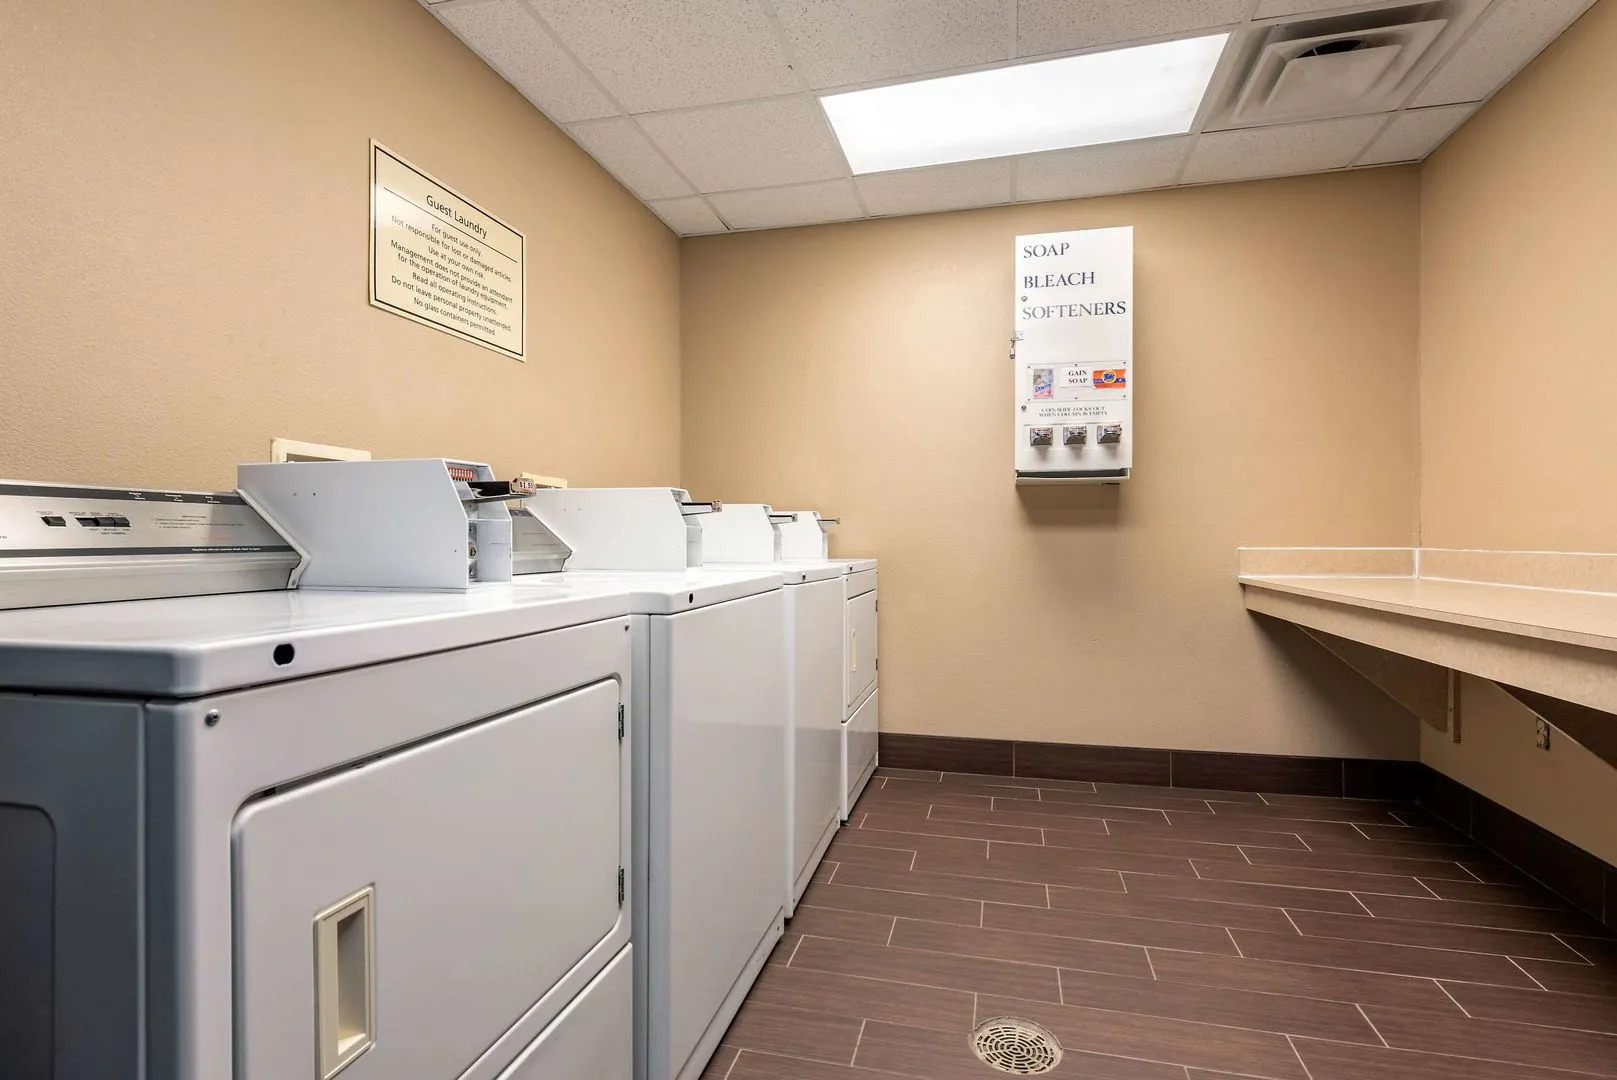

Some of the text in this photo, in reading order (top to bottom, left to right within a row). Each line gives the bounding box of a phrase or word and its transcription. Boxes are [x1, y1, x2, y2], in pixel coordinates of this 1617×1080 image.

[426, 195, 487, 239] Guest Laundry
[391, 215, 404, 228] Not
[405, 223, 440, 246] responsible
[441, 239, 451, 251] for
[451, 245, 461, 257] lost
[470, 255, 494, 274] damaged
[431, 223, 441, 234] For
[442, 231, 458, 244] guest
[459, 240, 469, 250] use
[1023, 242, 1070, 259] SOAP
[391, 239, 513, 304] Management does not provide an attendant
[428, 245, 439, 257] Use
[440, 253, 447, 261] at
[447, 256, 461, 268] your
[461, 264, 474, 274] own
[397, 252, 408, 264] for
[409, 258, 420, 270] the
[421, 265, 451, 284] operation
[451, 278, 459, 287] of
[459, 281, 480, 298] laundry
[412, 272, 429, 285] Read
[429, 279, 437, 289] all
[438, 284, 467, 304] operating
[1024, 271, 1095, 289] BLEACH
[391, 275, 402, 286] Do
[402, 281, 415, 291] not
[415, 285, 432, 299] leave
[433, 294, 458, 310] personal
[458, 304, 482, 321] property
[413, 297, 424, 307] No
[424, 302, 440, 314] glass
[439, 308, 470, 326] containers
[1022, 300, 1126, 320] SOFTENERS
[1068, 369, 1087, 377] GAIN
[1068, 377, 1088, 385] SOAP
